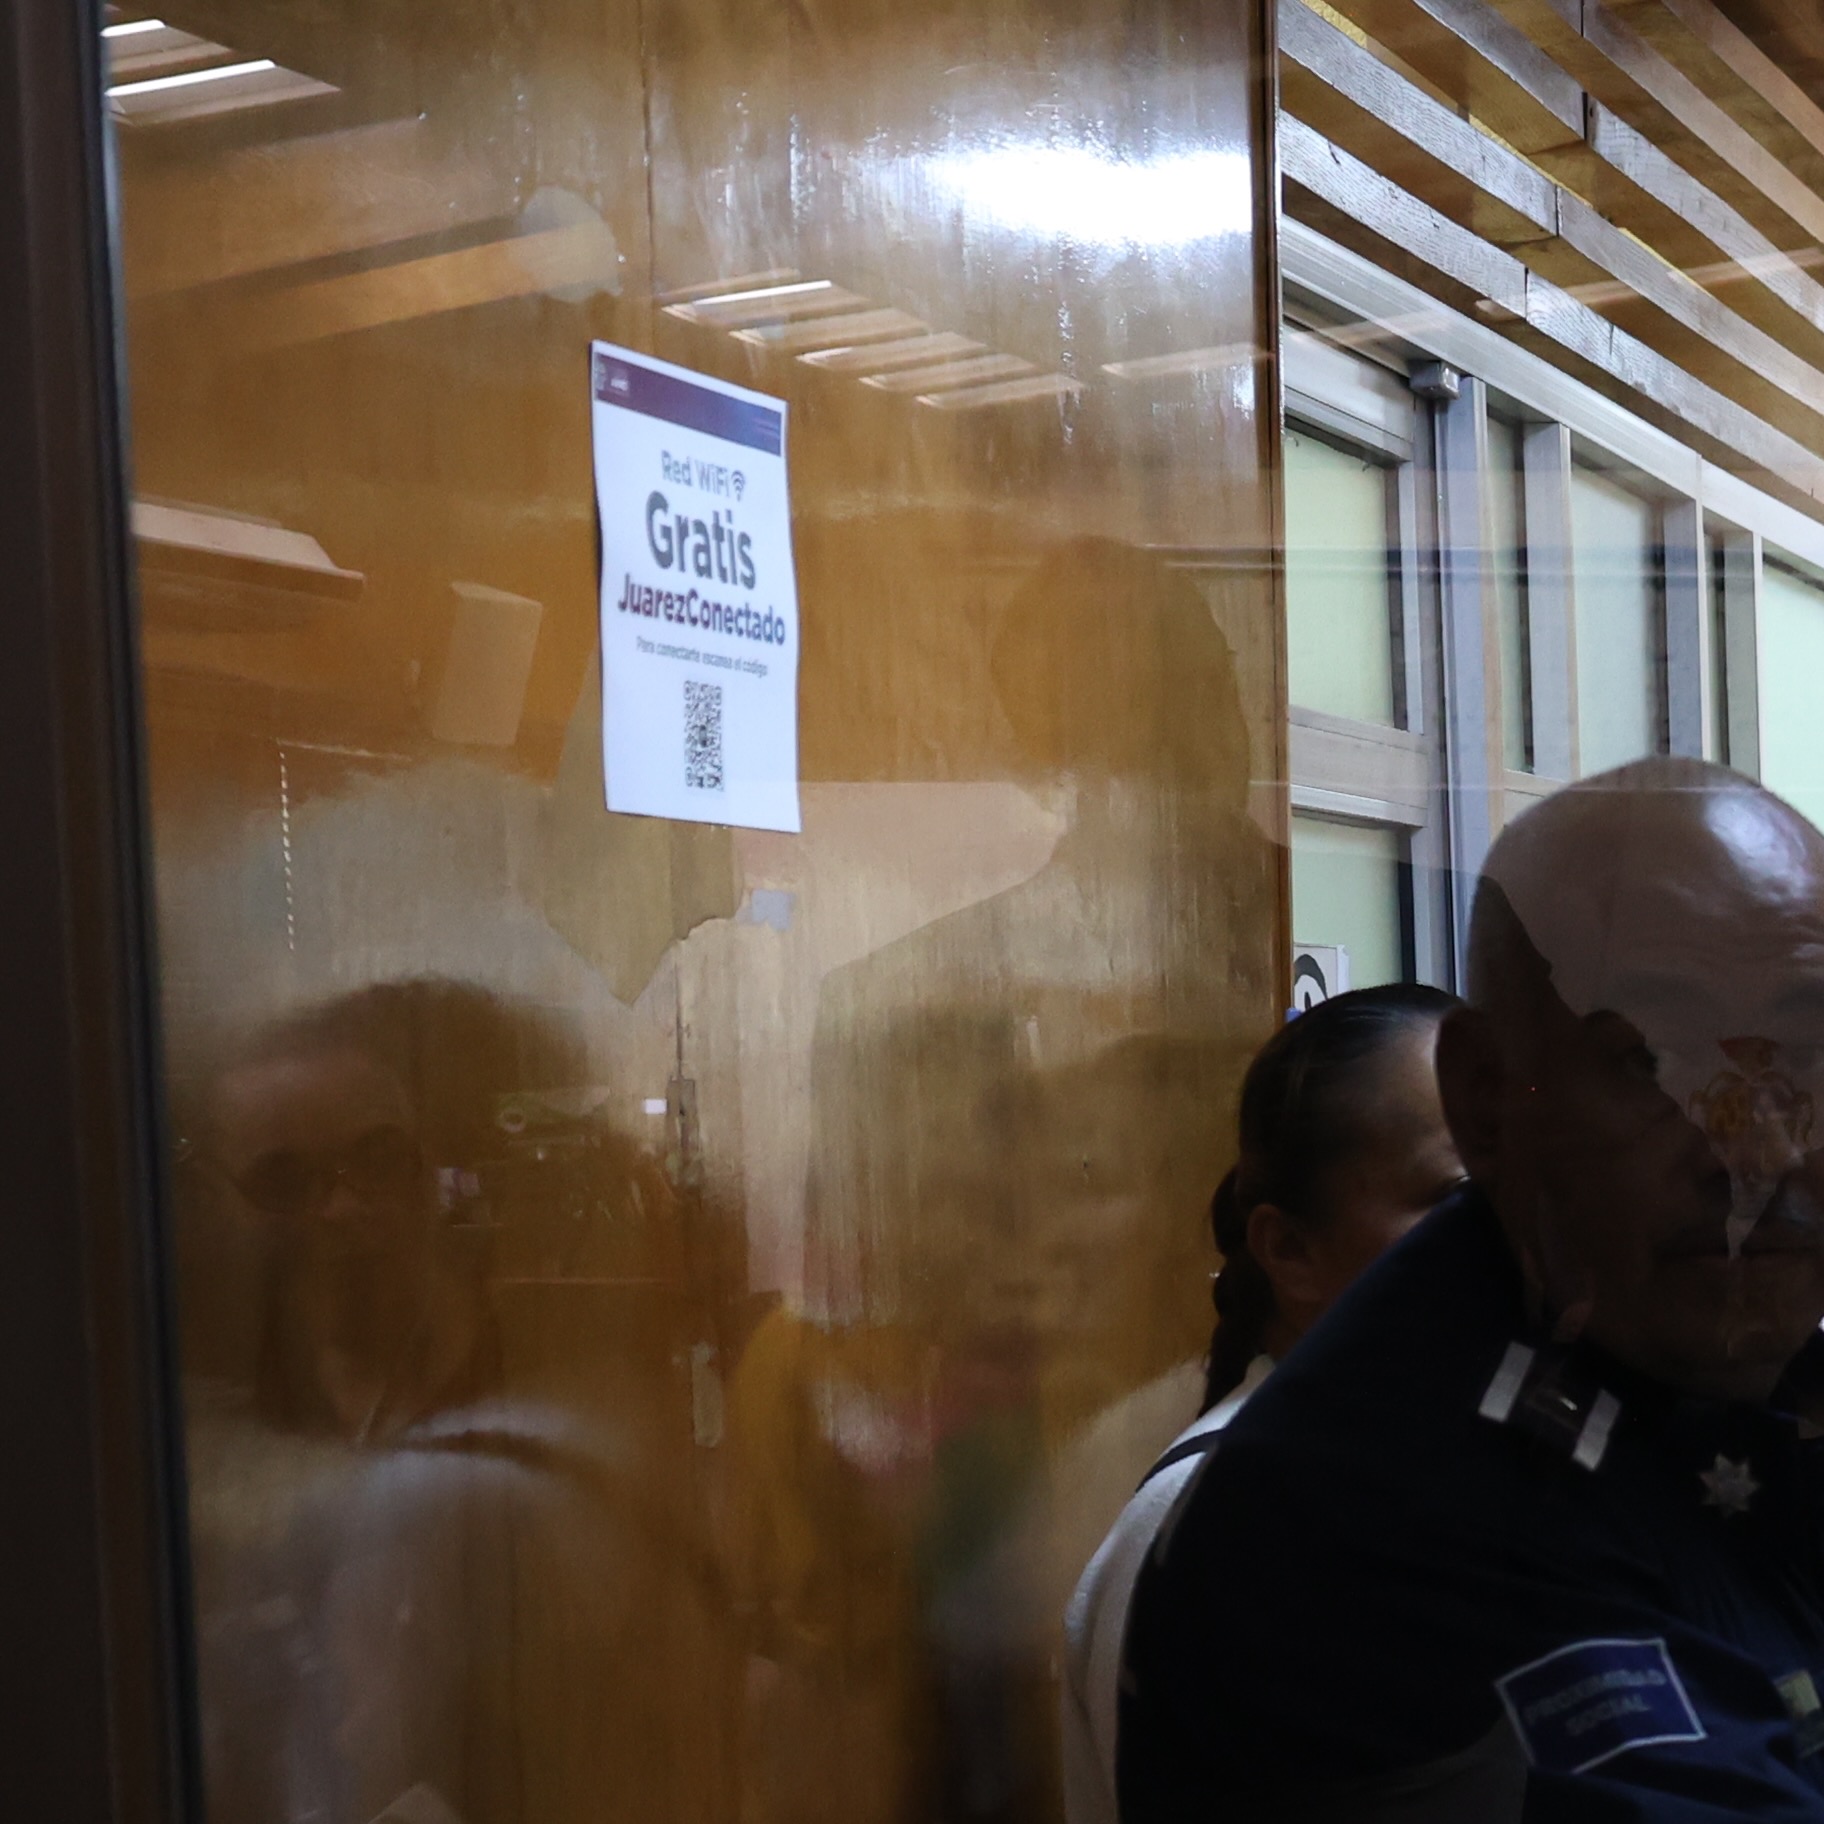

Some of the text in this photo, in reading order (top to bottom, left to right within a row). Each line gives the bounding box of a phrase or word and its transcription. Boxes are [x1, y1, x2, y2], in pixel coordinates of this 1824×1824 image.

[661, 449, 730, 498] Red WiFi
[645, 490, 757, 591] Gratis
[617, 572, 786, 646] JuarezConectado
